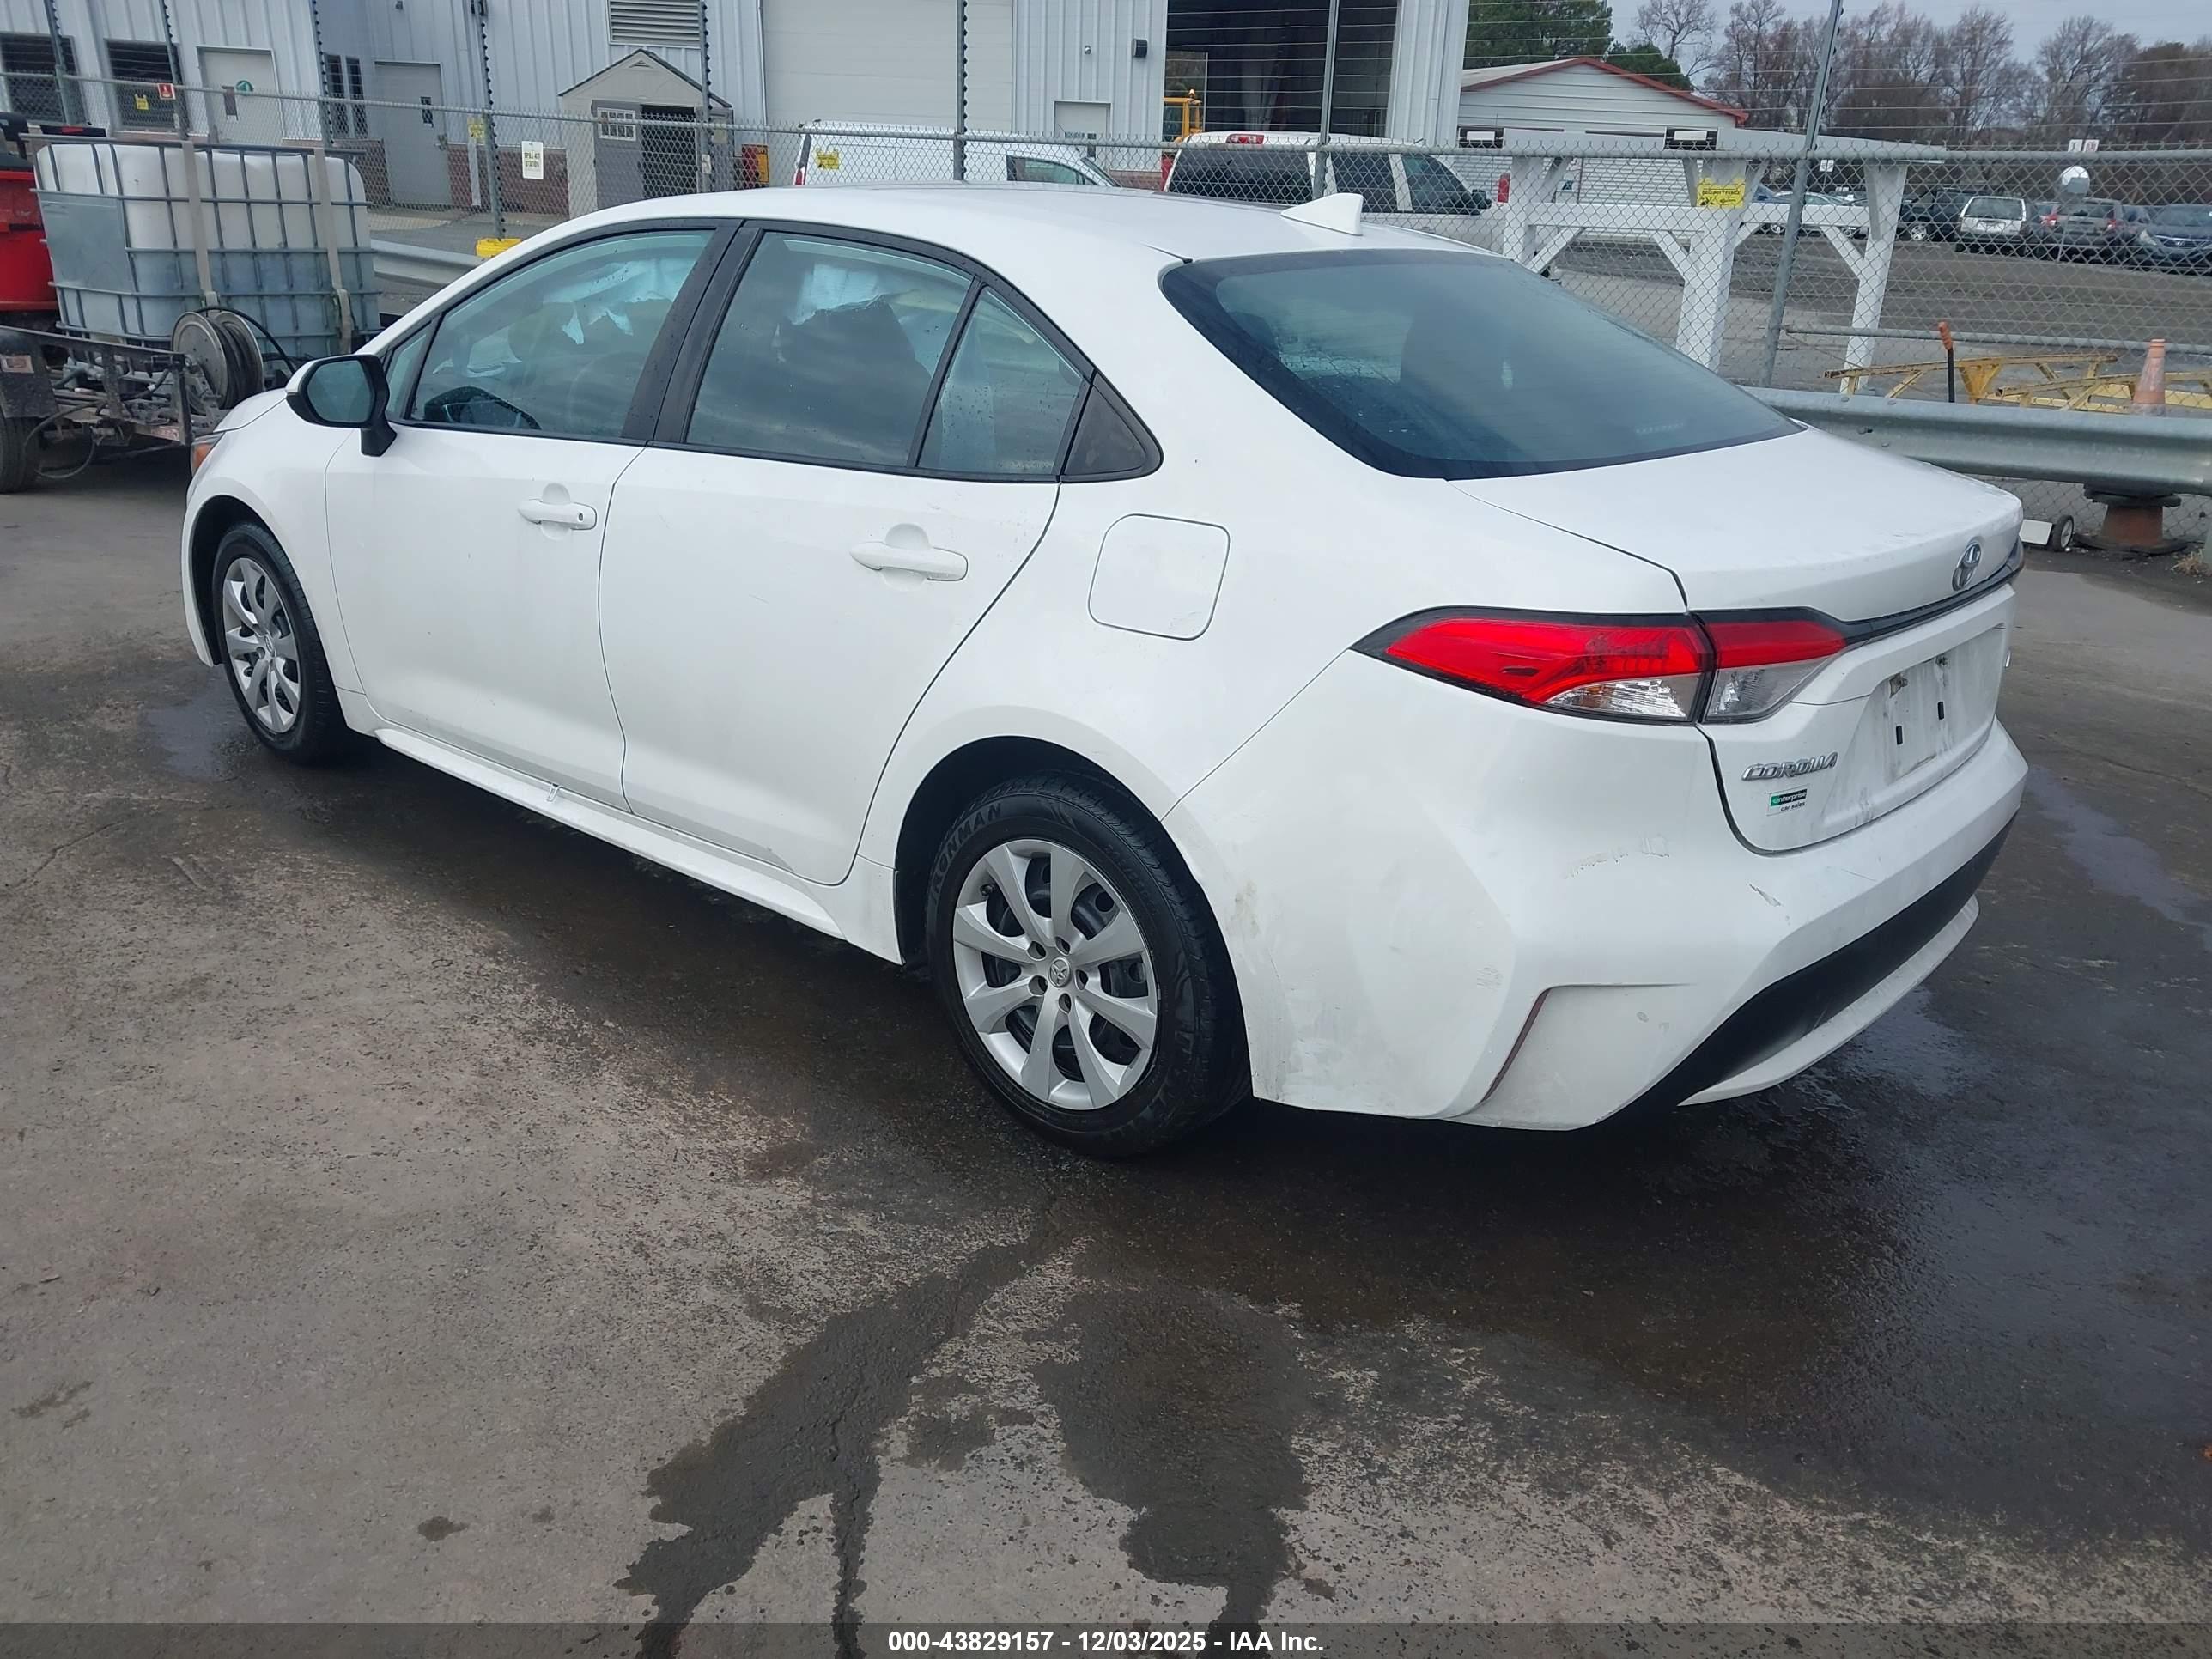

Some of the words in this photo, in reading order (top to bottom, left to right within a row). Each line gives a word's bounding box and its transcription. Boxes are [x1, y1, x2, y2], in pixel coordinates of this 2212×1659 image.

[1741, 752, 1838, 781] COROLLA
[1772, 790, 1807, 805] enterprise
[1791, 801, 1805, 810] sales
